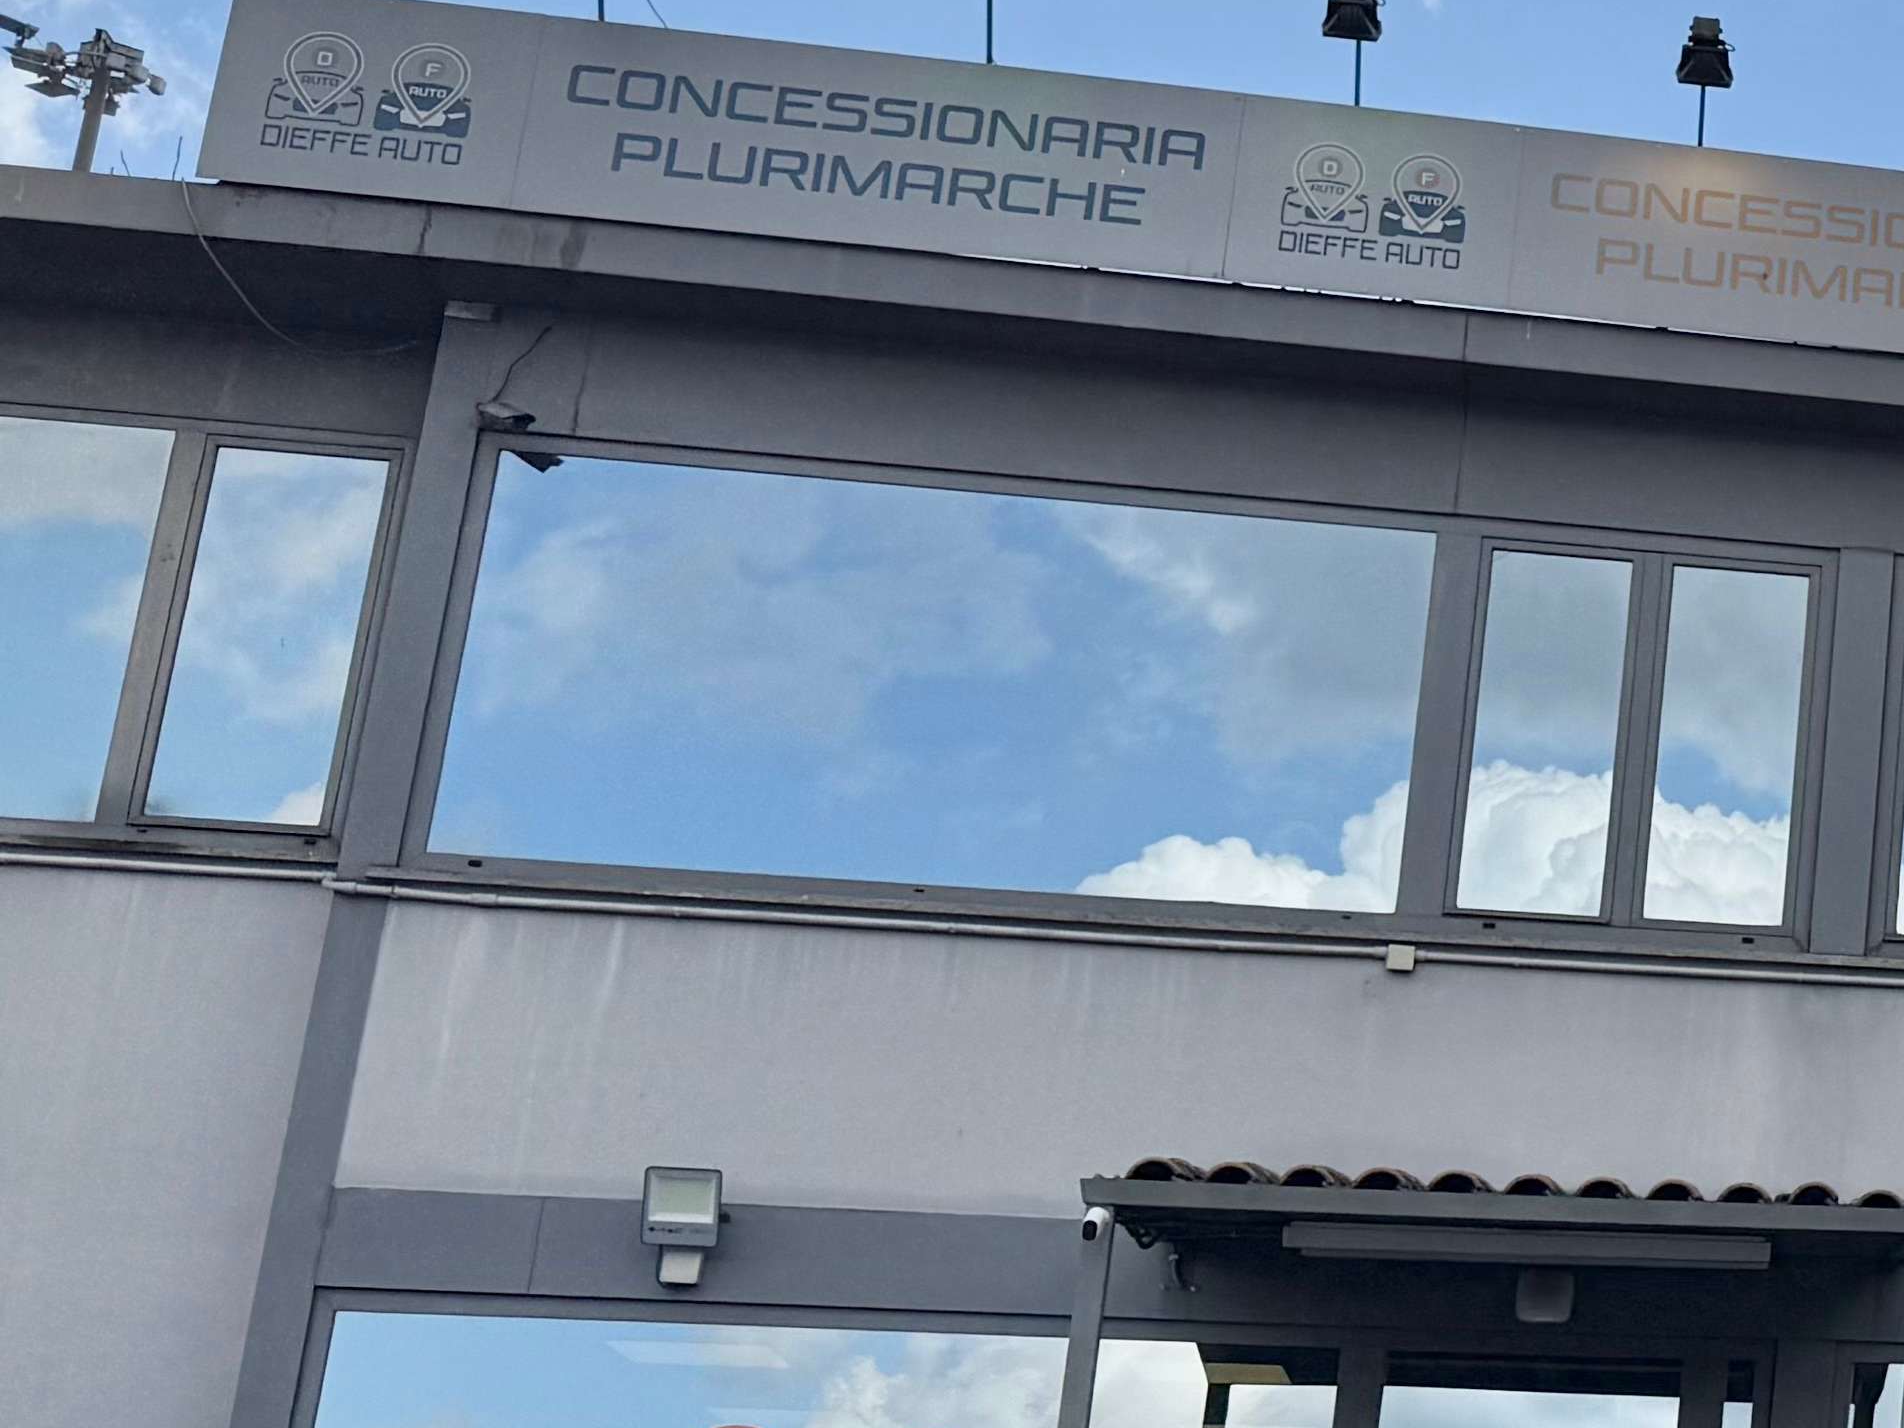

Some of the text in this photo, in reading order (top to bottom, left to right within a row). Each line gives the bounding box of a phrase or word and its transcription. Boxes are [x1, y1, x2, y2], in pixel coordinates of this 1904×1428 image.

[301, 74, 340, 88] AUTO
[408, 85, 448, 99] AUTO
[566, 64, 1206, 170] CONCESSIONARIA
[260, 124, 463, 165] DIEFFE AUTO
[611, 132, 1147, 225] PLURIMARCHE
[1310, 184, 1345, 196] AUTO
[1408, 194, 1443, 207] AUTO
[1278, 230, 1460, 269] DIEFFE AUTO
